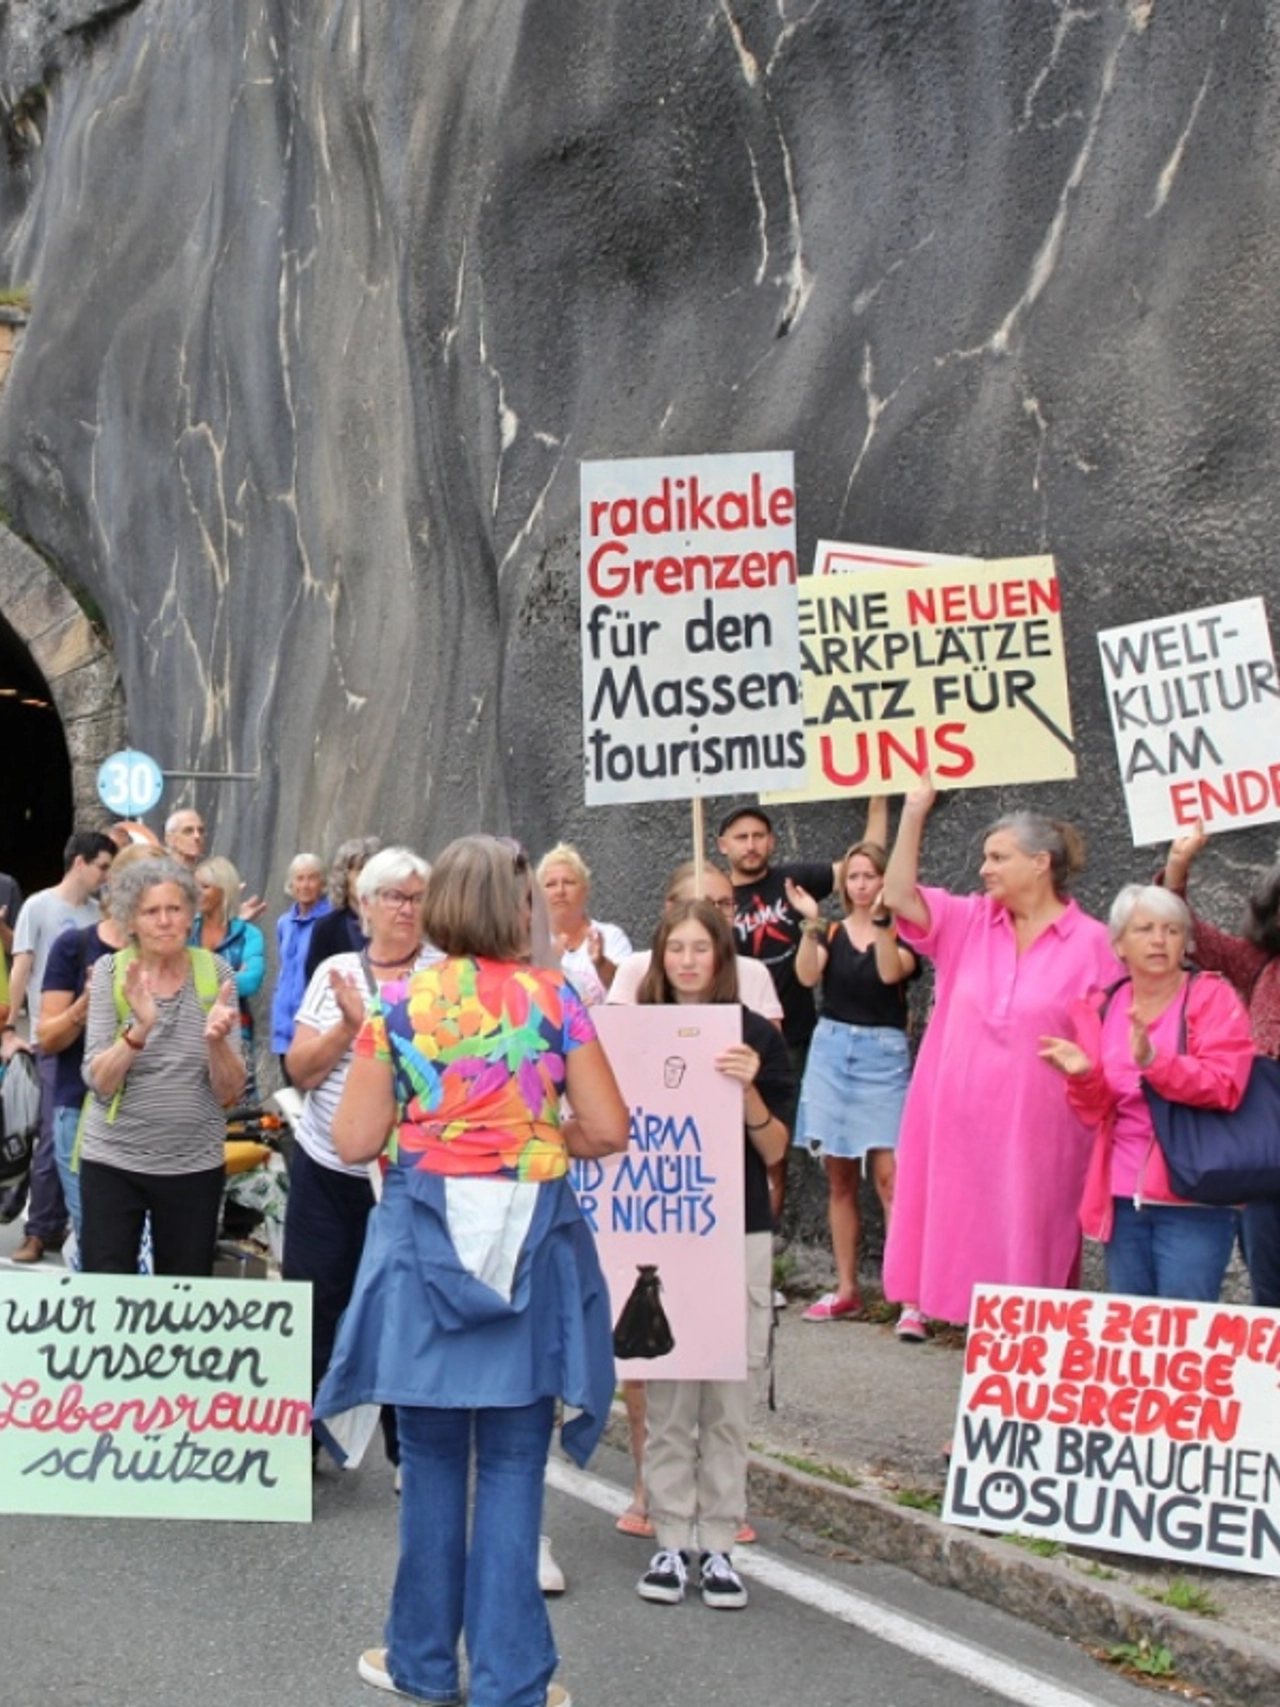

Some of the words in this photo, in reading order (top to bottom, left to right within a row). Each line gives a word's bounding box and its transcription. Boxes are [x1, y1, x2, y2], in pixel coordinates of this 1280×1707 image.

[589, 472, 796, 537] radikale
[587, 540, 798, 598] Grenzen
[587, 604, 661, 660] für
[684, 598, 771, 653] den
[798, 592, 889, 635] EINE
[907, 577, 1061, 626] NEUEN
[799, 619, 1052, 676] ARKPLÄTZE
[1101, 617, 1238, 679] WELT-
[1113, 659, 1280, 730] KULTUR
[820, 722, 975, 786] UNS
[1126, 726, 1223, 784] AM
[106, 763, 154, 805] 30
[612, 1155, 716, 1194] MÜLL
[612, 1194, 717, 1236] NICHTS
[3, 1277, 97, 1335] wir
[114, 1283, 293, 1337] müssen
[973, 1296, 1092, 1340] KEINE
[1100, 1302, 1198, 1347] ZEIT
[38, 1342, 268, 1388] unseren
[966, 1332, 1048, 1376] FÜR
[1060, 1339, 1236, 1397] BILLIGE
[967, 1374, 1241, 1442] AUSREDEN
[21, 1431, 278, 1488] schützen
[963, 1415, 1042, 1471] WIR
